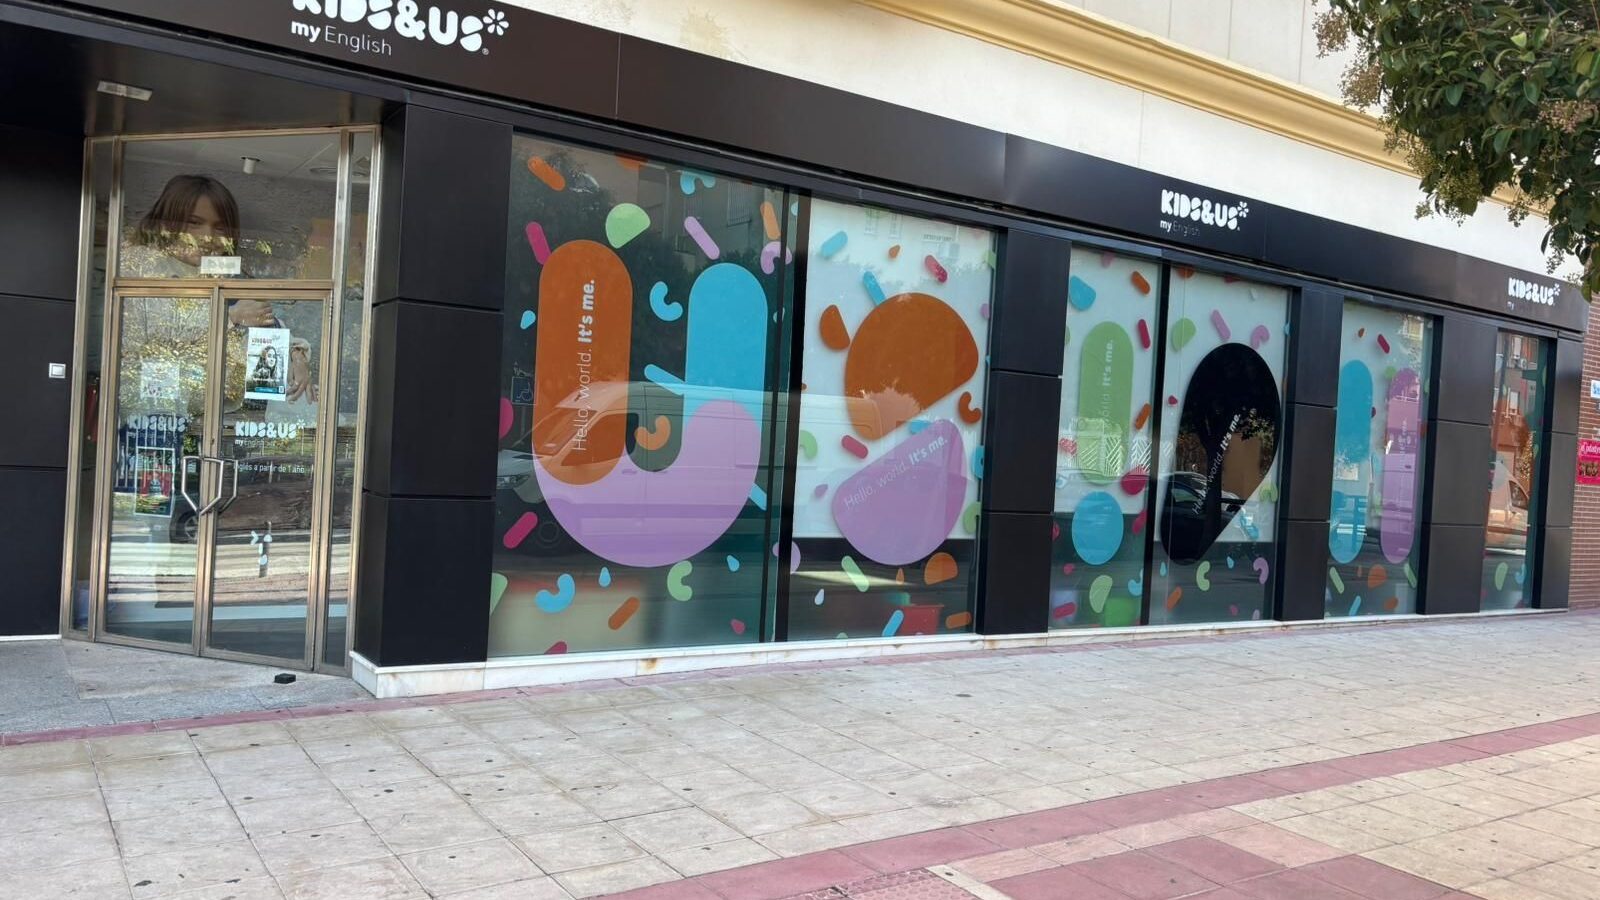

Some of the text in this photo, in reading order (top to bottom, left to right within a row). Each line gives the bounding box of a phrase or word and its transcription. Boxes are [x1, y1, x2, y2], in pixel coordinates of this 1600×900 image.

[291, 21, 392, 56] my English
[1161, 189, 1239, 230] KIDS&US
[1160, 220, 1172, 232] my
[582, 280, 594, 311] me.
[1508, 277, 1554, 306] KIDS&US
[577, 315, 593, 343] It's
[576, 348, 592, 400] world.
[235, 421, 297, 439] KIDS&US
[1220, 431, 1232, 451] It's
[1229, 413, 1241, 432] me.
[909, 447, 928, 466] It's
[928, 436, 948, 453] me.
